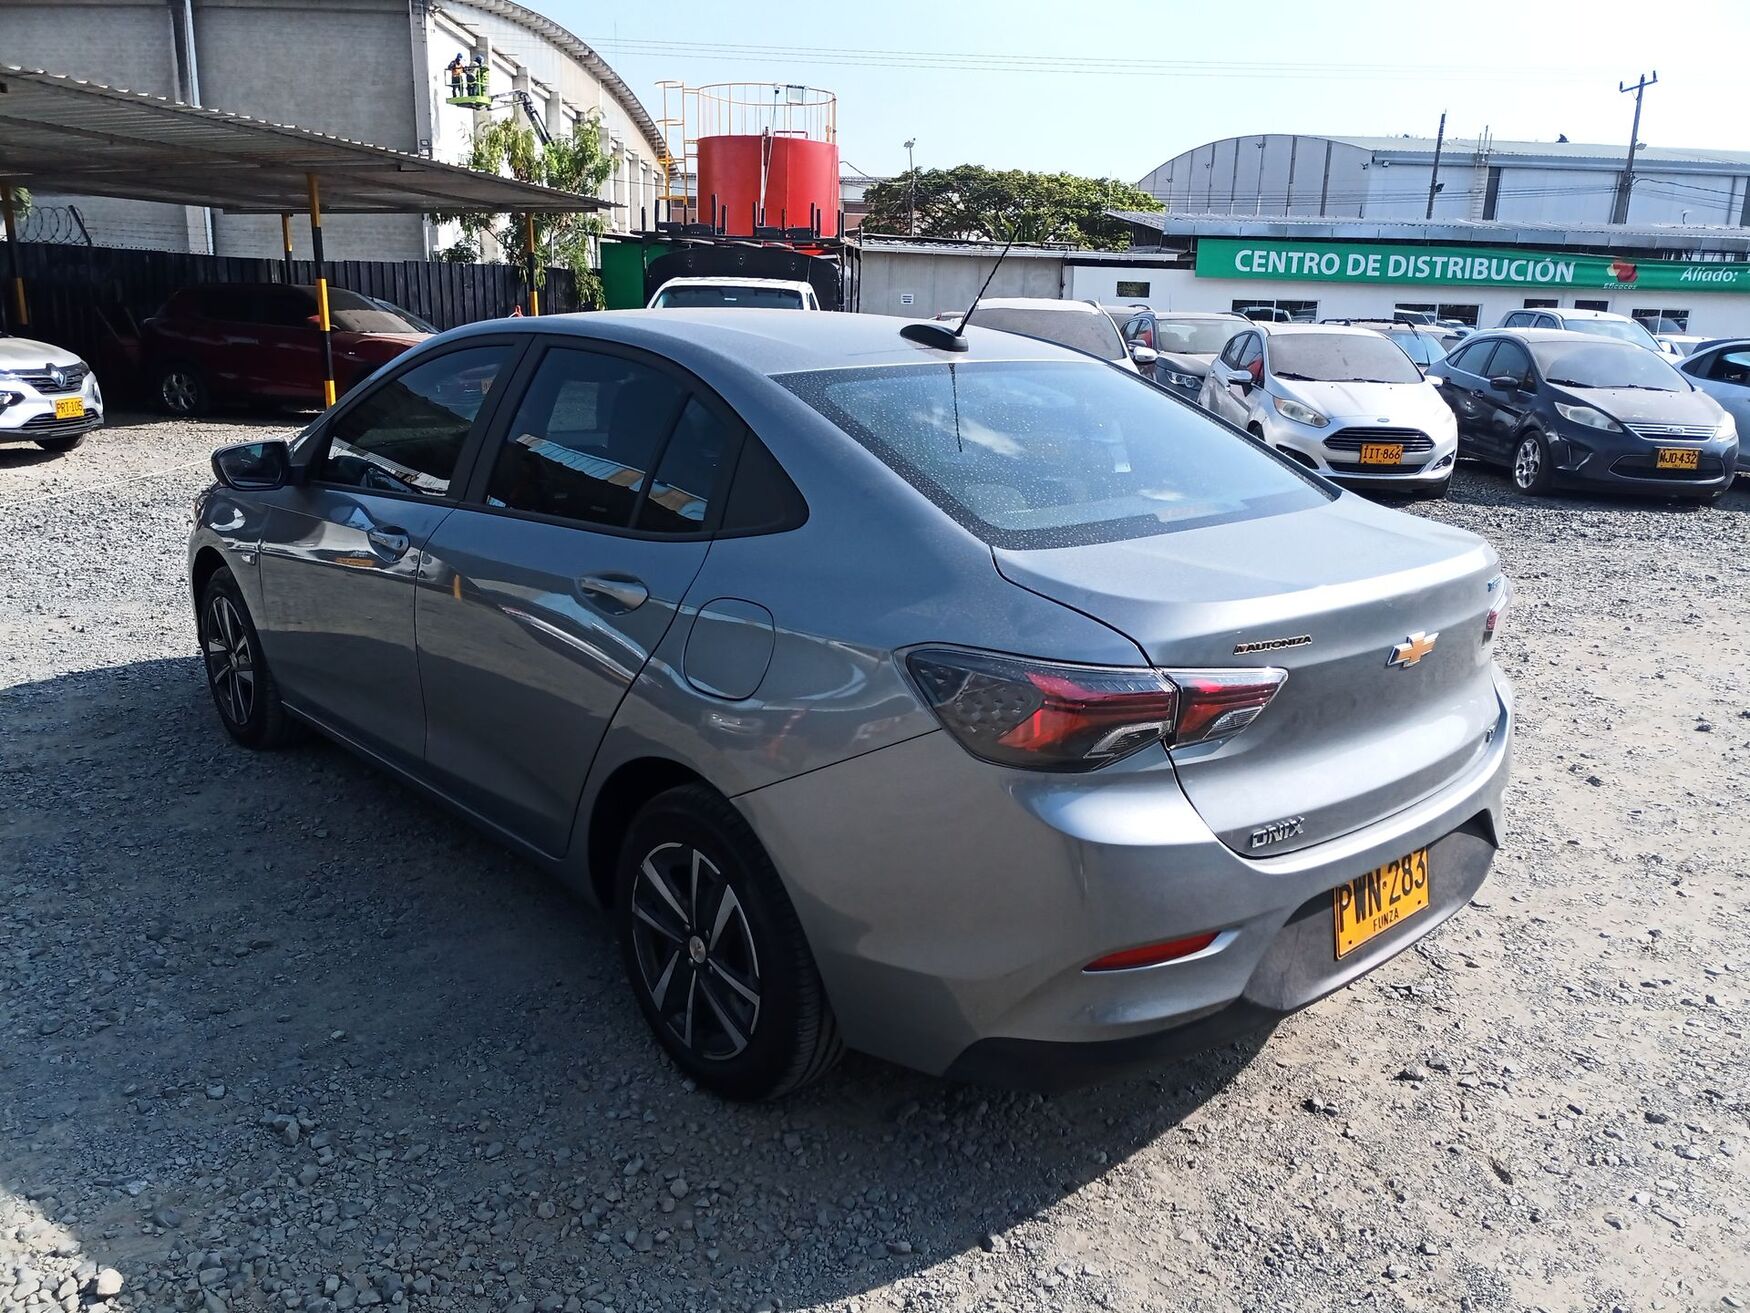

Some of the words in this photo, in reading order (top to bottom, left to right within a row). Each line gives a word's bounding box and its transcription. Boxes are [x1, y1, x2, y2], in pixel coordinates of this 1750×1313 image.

[1235, 249, 1340, 275] CENTRO
[1346, 253, 1382, 276] DE
[1387, 254, 1576, 283] DISTRIBUCIÓN
[1680, 266, 1739, 283] Aliado:
[1246, 634, 1313, 653] AUTONIZA
[1250, 815, 1305, 849] ONIX
[1372, 907, 1400, 932] FUNZA
